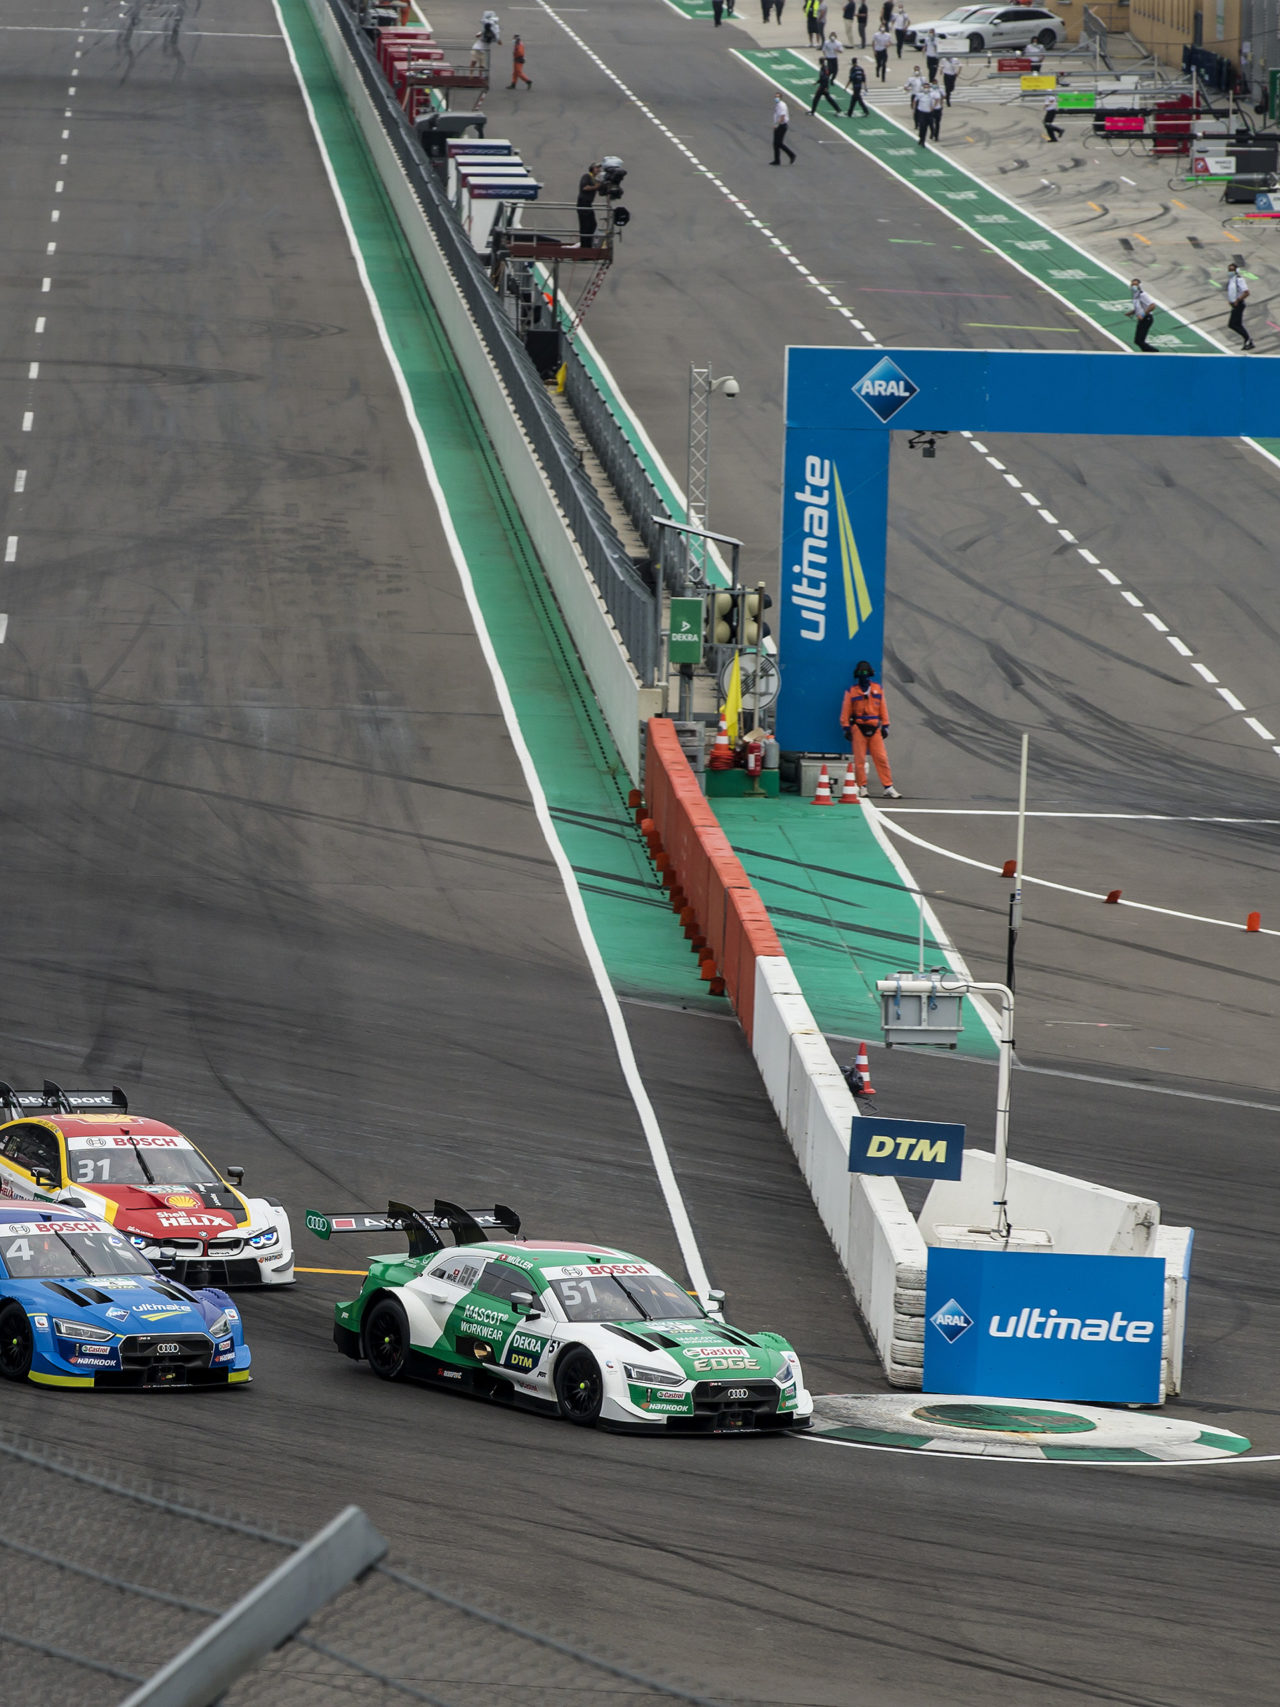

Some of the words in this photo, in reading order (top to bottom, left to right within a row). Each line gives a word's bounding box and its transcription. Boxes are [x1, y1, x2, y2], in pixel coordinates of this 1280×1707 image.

[861, 380, 910, 397] ARAL
[791, 455, 831, 642] ultimate
[671, 633, 699, 642] DEKRA
[112, 1136, 179, 1148] BOSCH
[867, 1135, 948, 1164] DTM
[76, 1158, 111, 1183] 31
[156, 1211, 187, 1219] Shell
[158, 1214, 233, 1227] HELIX
[35, 1221, 101, 1233] BOSCH
[5, 1238, 34, 1260] 4
[506, 1254, 534, 1271] MÜLLER
[587, 1263, 651, 1277] BOSCH
[561, 1280, 599, 1306] 51
[132, 1303, 192, 1312] ultimate
[460, 1320, 503, 1341] WORKWEAR
[935, 1313, 968, 1328] ARAL
[989, 1308, 1155, 1344] ultimate
[88, 1346, 109, 1354] Castrol
[513, 1334, 541, 1353] DEKRA
[700, 1347, 745, 1358] Castrol
[511, 1353, 533, 1369] DTM
[693, 1357, 761, 1373] EDGE
[663, 1391, 685, 1400] Castrol
[648, 1402, 689, 1412] HANKOOK
